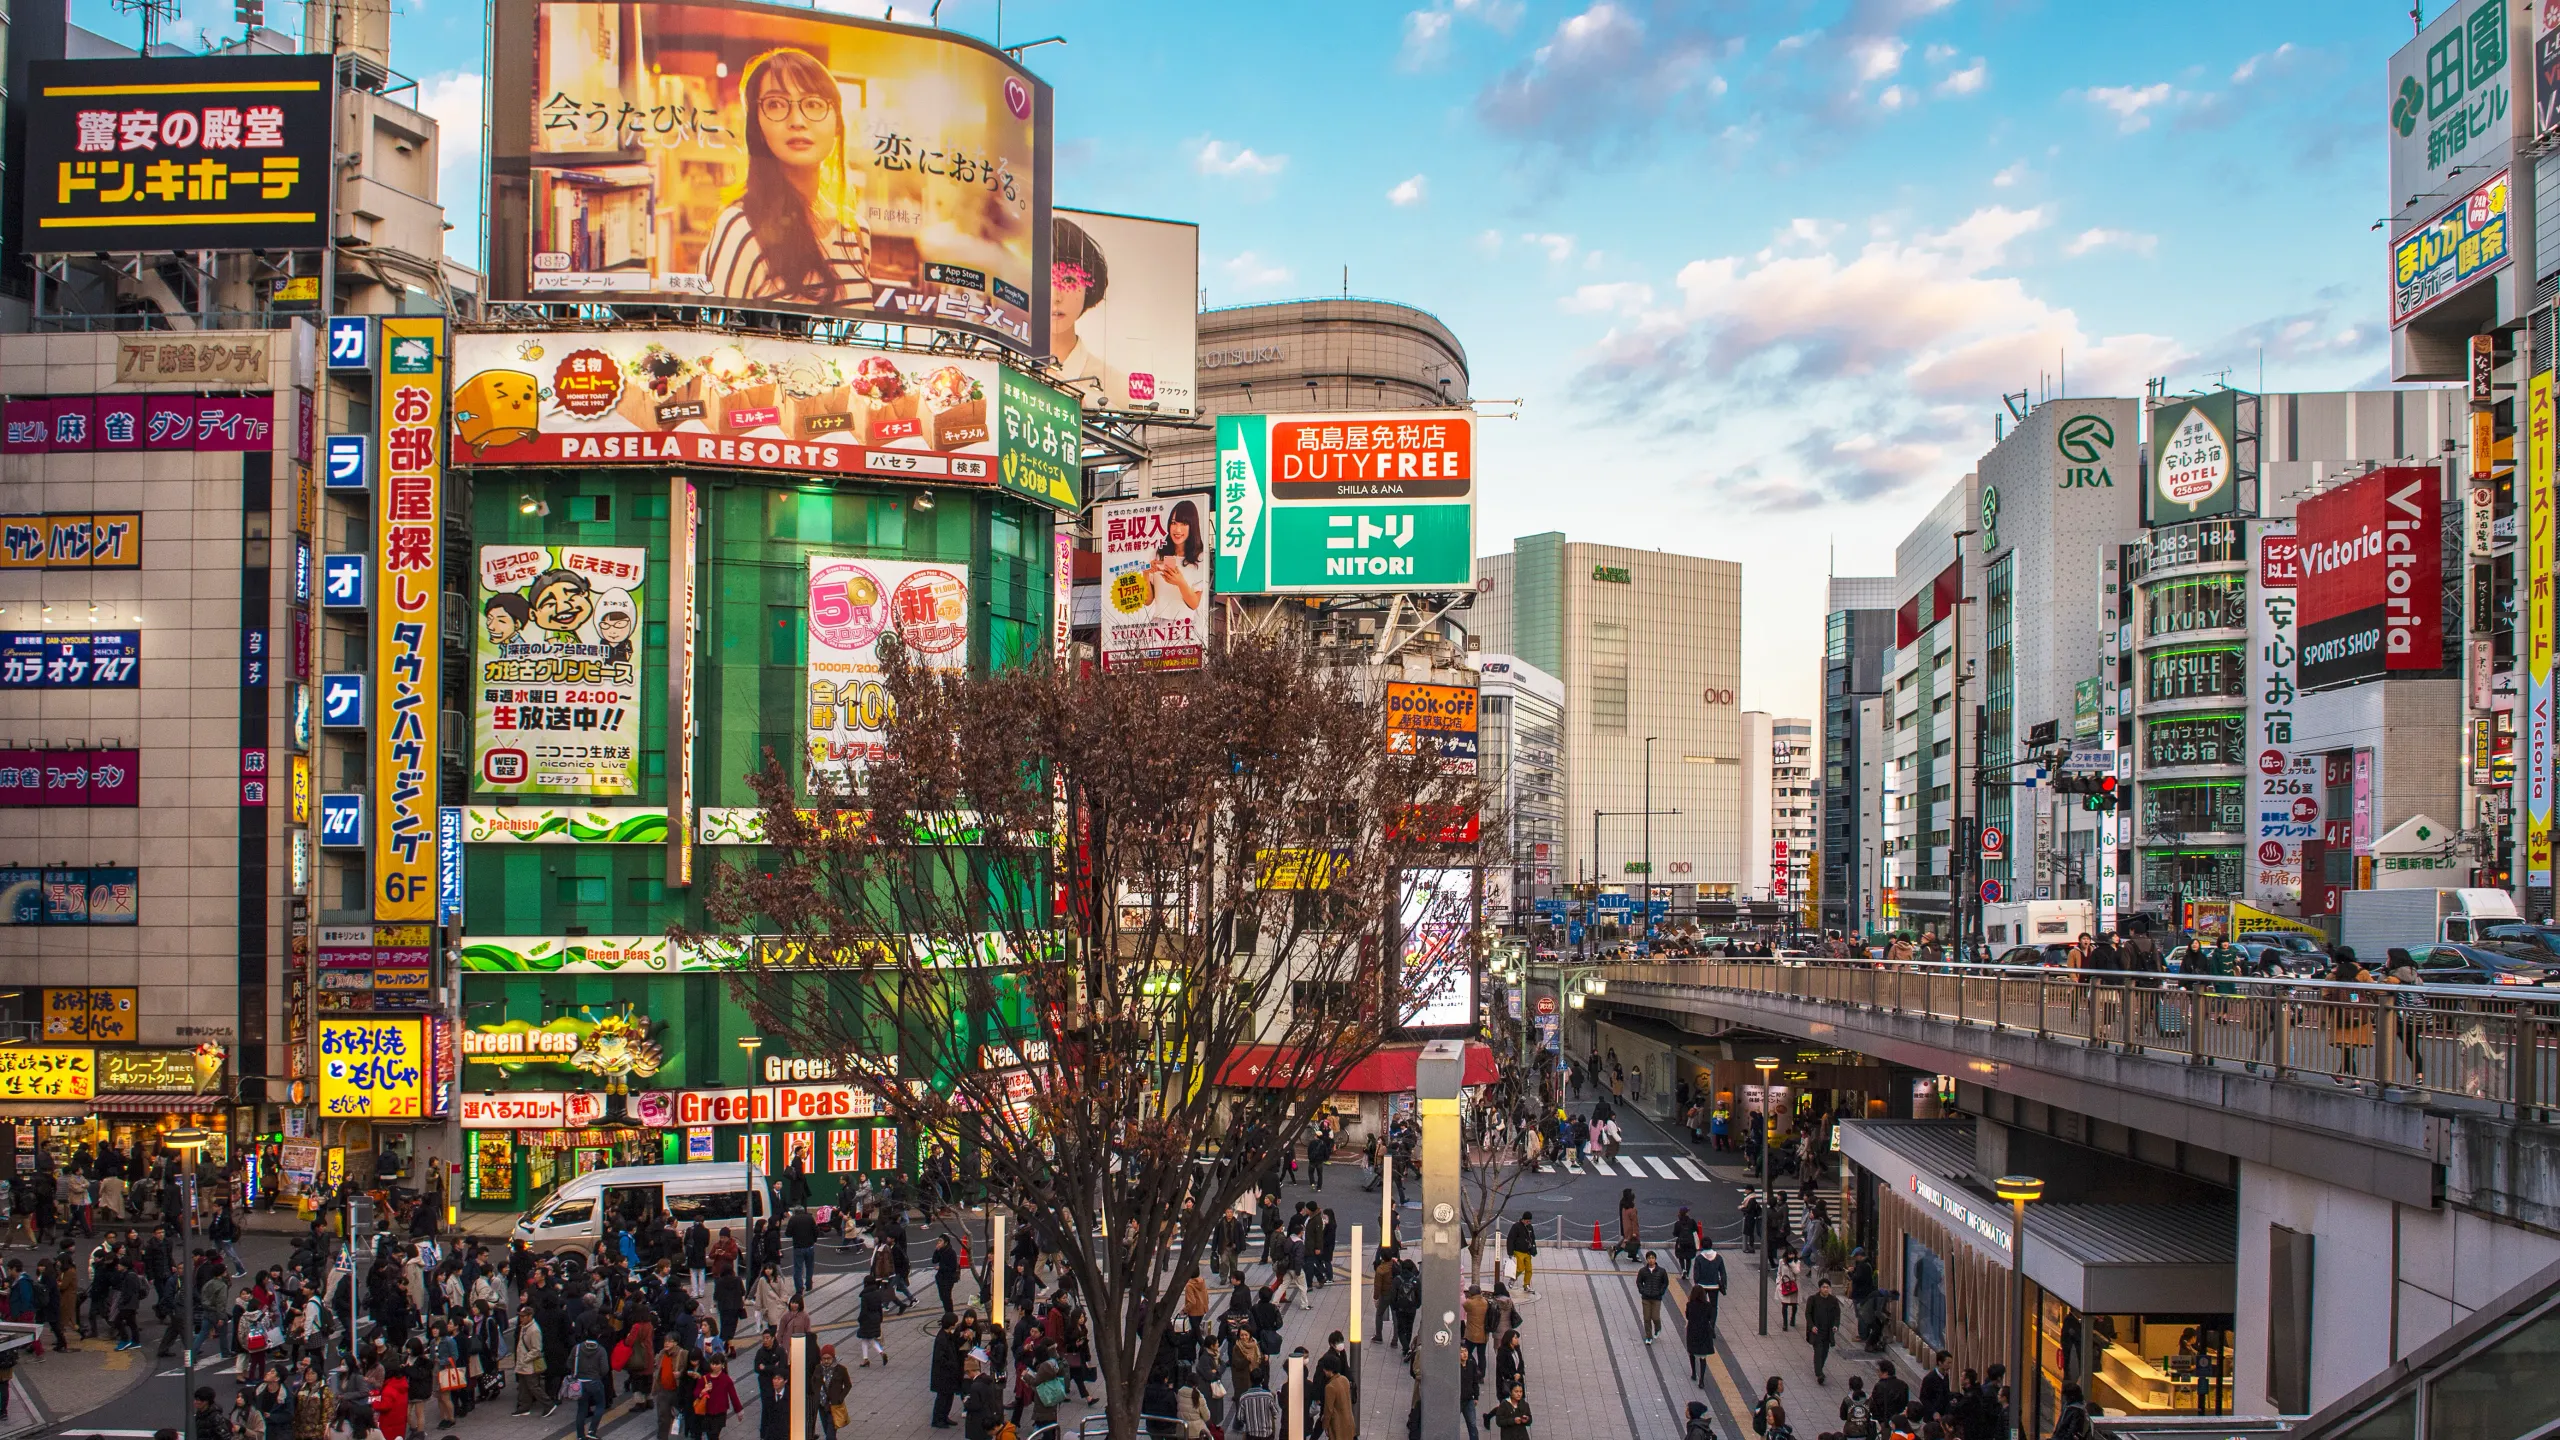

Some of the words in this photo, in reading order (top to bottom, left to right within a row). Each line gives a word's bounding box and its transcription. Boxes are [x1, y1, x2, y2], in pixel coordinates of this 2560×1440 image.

[2426, 0, 2508, 122] 田園
[542, 91, 737, 139] 会うたびに、
[76, 105, 284, 152] 驚安の殿堂
[2427, 83, 2509, 171] 新宿ビル
[874, 134, 1027, 211] 恋におちる。
[2470, 208, 2487, 224] OPEN
[2398, 216, 2465, 283] まんが
[2457, 223, 2504, 276] 喫茶
[538, 276, 615, 288] ハッピーメール
[669, 275, 696, 288] 検索
[945, 267, 961, 279] App
[961, 269, 980, 281] Store
[2397, 266, 2455, 315] マンボー
[873, 288, 1030, 343] ハッピーメール
[123, 345, 155, 371] 7F
[158, 344, 196, 372] 麻雀
[572, 358, 602, 373] 名物
[1159, 387, 1188, 396] ワクワク
[661, 406, 700, 419] 生チョコ
[735, 408, 774, 423] ミルキー
[1003, 383, 1078, 427] 豪華カプセルホテル
[8, 423, 48, 443] 当ビル
[243, 419, 269, 439] 7F
[811, 417, 845, 429] バナナ
[881, 422, 913, 435] イチゴ
[945, 428, 985, 441] キャラメル
[1003, 405, 1077, 467] 安心お宿
[2174, 433, 2214, 448] カプセル
[562, 437, 681, 458] PASELA
[698, 439, 839, 467] RESORTS
[2165, 445, 2222, 470] 安心お宿
[873, 455, 917, 468] パセラ
[957, 462, 981, 474] 検索
[1019, 466, 1048, 494] 30秒
[2058, 468, 2114, 489] JRA
[2170, 466, 2218, 485] HOTEL
[387, 385, 434, 611] お部屋探し
[1337, 484, 1369, 495] SHILLA
[1371, 485, 1378, 494] &
[1380, 484, 1404, 495] ANA
[2176, 486, 2192, 496] 256
[1225, 459, 1246, 549] 徒歩2分
[1108, 514, 1167, 542] 高収入
[1326, 514, 1415, 549] ニトリ
[4, 522, 130, 560] タウンハウジング
[1108, 539, 1167, 553] 求人情報サイト
[486, 551, 539, 573] パチスロの
[2300, 525, 2382, 579] Victoria
[494, 567, 537, 585] 楽しさを
[1326, 556, 1414, 576] NITORI
[2386, 479, 2422, 654] Victoria
[1120, 576, 1137, 586] 現金
[900, 585, 938, 626] 新
[2152, 609, 2221, 635] LUXURY
[1153, 625, 1195, 642] NET
[2304, 637, 2346, 667] SPORTS
[2348, 629, 2380, 656] SHOP
[4, 657, 89, 682] カラオケ
[92, 657, 137, 681] 747
[1481, 663, 1510, 674] KEIO
[2153, 655, 2221, 679] CAPSULE
[2264, 595, 2296, 744] 安心お宿
[485, 689, 558, 703] 毎週水曜日
[2153, 676, 2220, 698] HOTEL
[390, 622, 433, 864] タウンハウジング
[536, 746, 630, 760] ニコニコ生放送
[2152, 741, 2217, 762] 安心お宿
[2534, 699, 2547, 798] Victoria
[494, 757, 518, 766] WEB
[497, 767, 516, 776] 放送
[540, 759, 594, 769] niconico
[601, 761, 627, 769] Live
[2287, 767, 2317, 775] カプセル
[47, 767, 125, 788] フォーシーズン
[245, 752, 264, 802] 麻雀
[539, 775, 579, 784] エンデック
[600, 776, 618, 784] 検索
[323, 808, 358, 834] 747
[489, 819, 539, 831] Pachislo
[2261, 824, 2317, 837] タブレット
[1775, 840, 1789, 897] 世界堂
[2385, 857, 2456, 870] 田園新宿ビル
[385, 872, 428, 903] 6F
[2260, 870, 2301, 886] 新宿の
[20, 907, 39, 920] 3F
[587, 949, 619, 961] Green
[623, 949, 650, 961] Peas
[322, 1026, 406, 1055] お好焼
[464, 1030, 523, 1053] Green
[527, 1030, 578, 1053] Peas
[110, 1056, 167, 1072] クレープ
[6, 1076, 62, 1095] 生そば
[110, 1073, 194, 1084] 牛乳ソフトクリーム
[389, 1097, 418, 1115] 2F
[464, 1101, 562, 1119] 選べるスロット
[572, 1097, 591, 1114] 新
[681, 1093, 768, 1123] Green
[781, 1088, 850, 1118] Peas
[1916, 1178, 1942, 1209] SHINJUKU
[1943, 1194, 1967, 1223] TOURIST
[1967, 1210, 2012, 1252] INFORMATION
